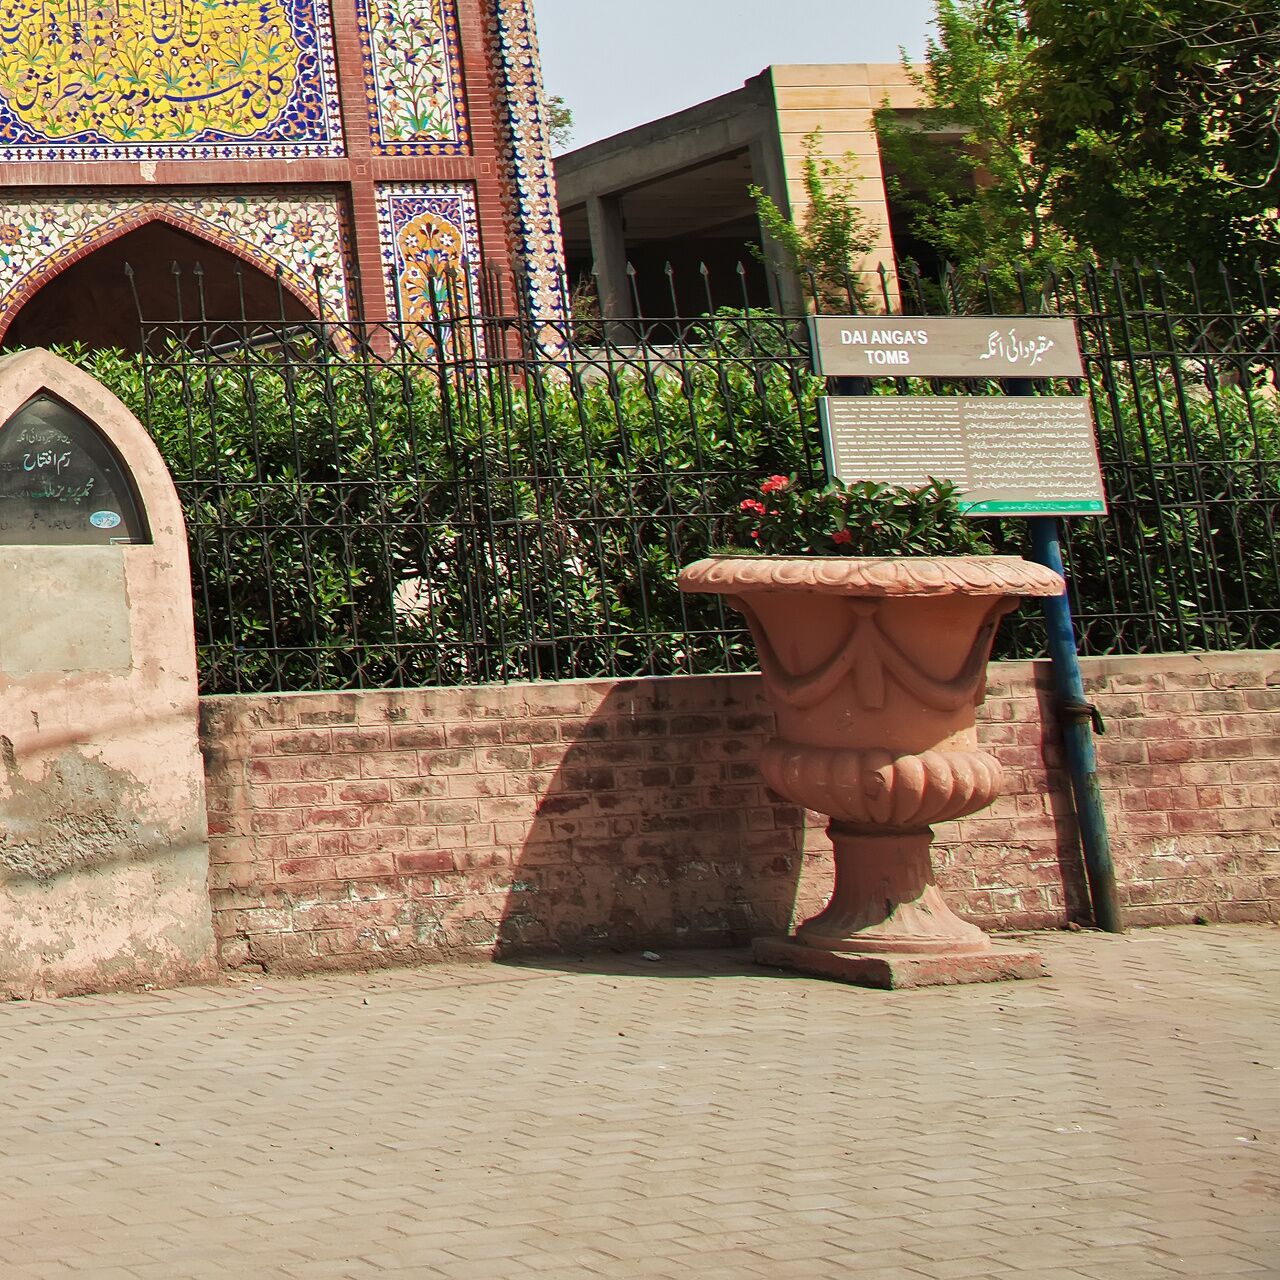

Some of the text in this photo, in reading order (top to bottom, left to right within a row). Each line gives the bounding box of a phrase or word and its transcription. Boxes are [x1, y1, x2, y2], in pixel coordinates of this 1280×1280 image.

[840, 330, 928, 345] DAI ANGA'S
[864, 350, 910, 364] TOMB
